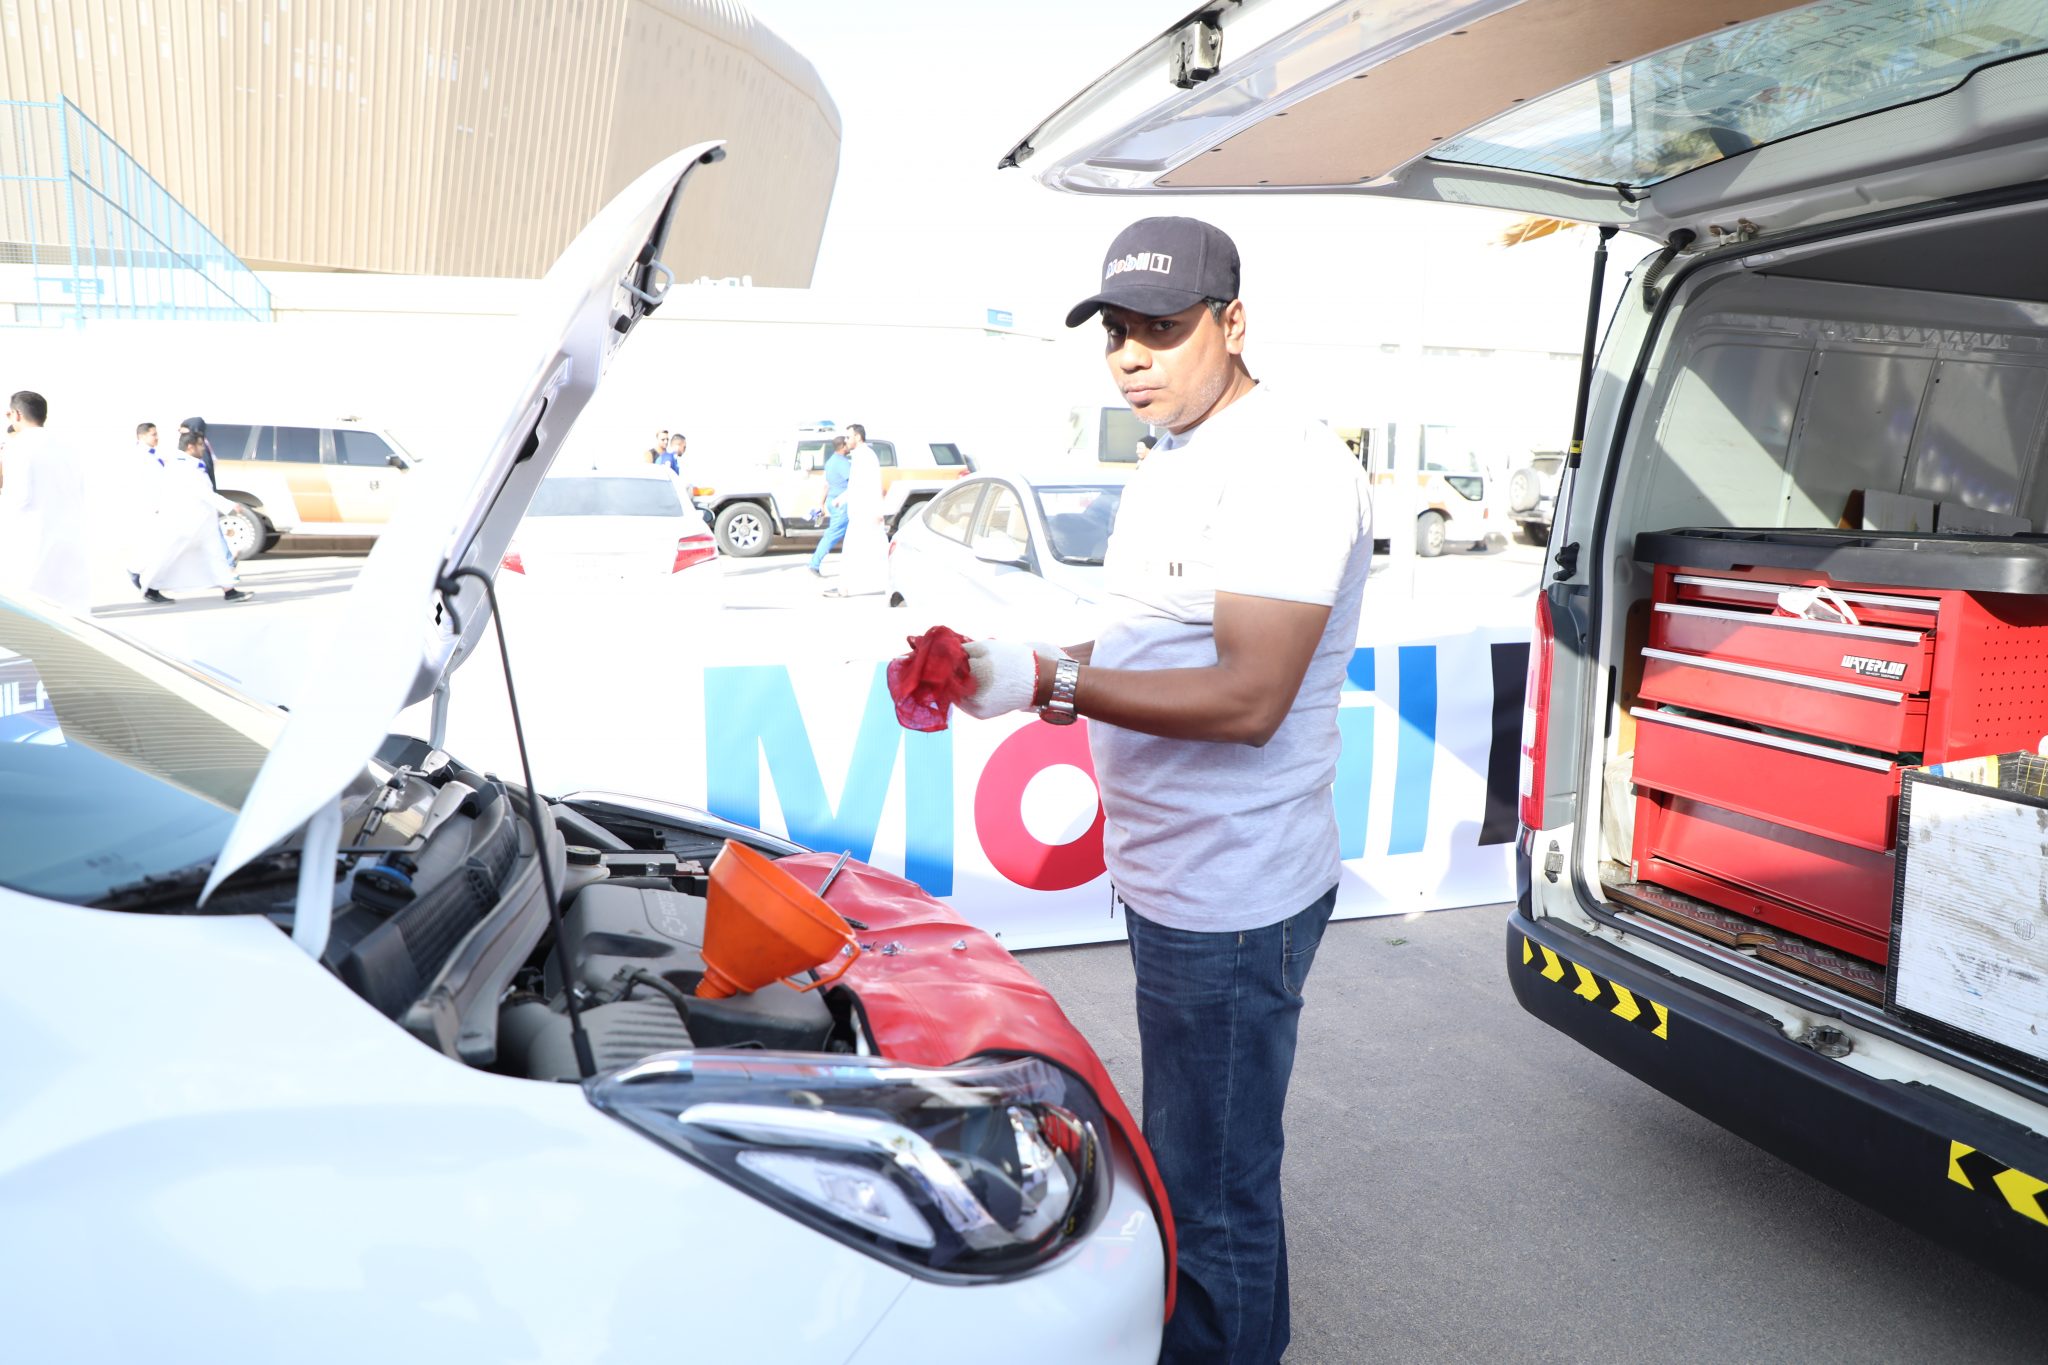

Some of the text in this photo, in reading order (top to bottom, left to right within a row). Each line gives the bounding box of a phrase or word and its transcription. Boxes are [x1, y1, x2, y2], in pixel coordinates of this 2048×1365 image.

[1105, 252, 1150, 281] Mobil
[1841, 655, 1906, 676] WATERLOO
[703, 643, 1437, 898] Moil
